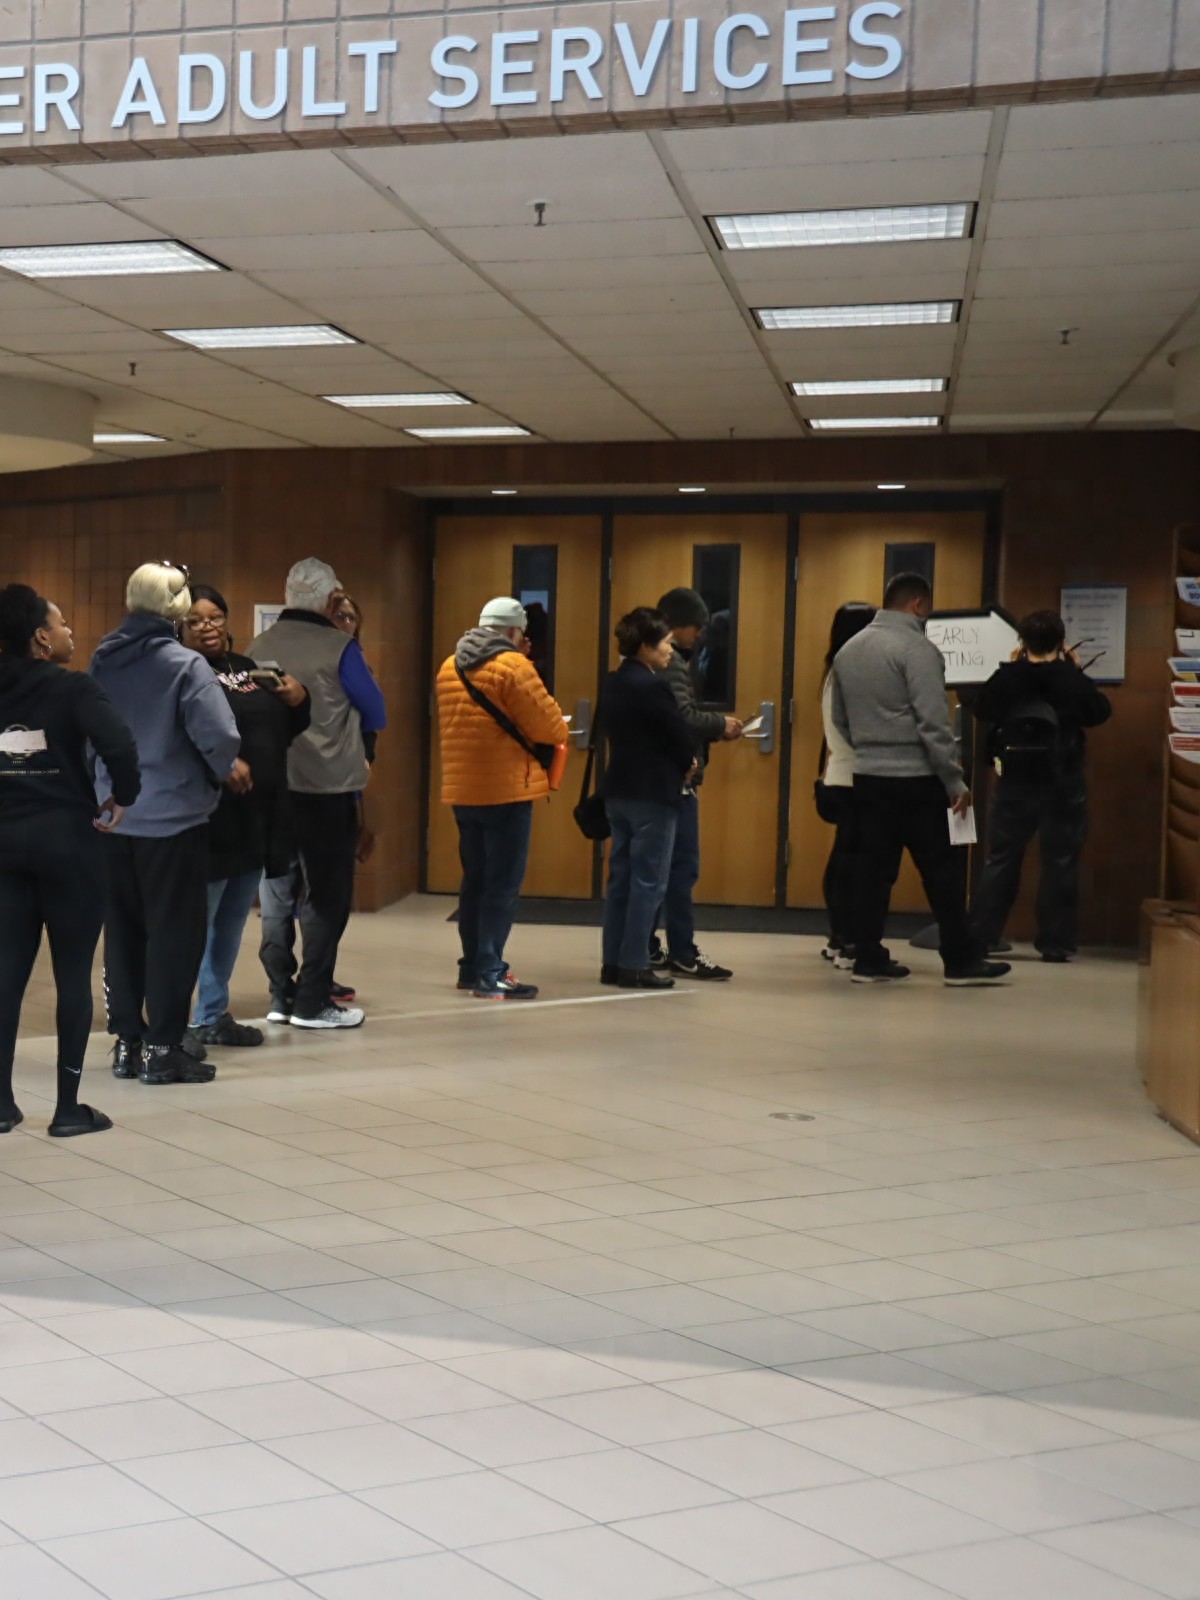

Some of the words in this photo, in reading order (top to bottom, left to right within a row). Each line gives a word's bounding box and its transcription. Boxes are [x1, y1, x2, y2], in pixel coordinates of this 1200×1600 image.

[111, 40, 398, 128] ADULT
[428, 1, 904, 109] SERVICES
[926, 624, 980, 646] EARLY
